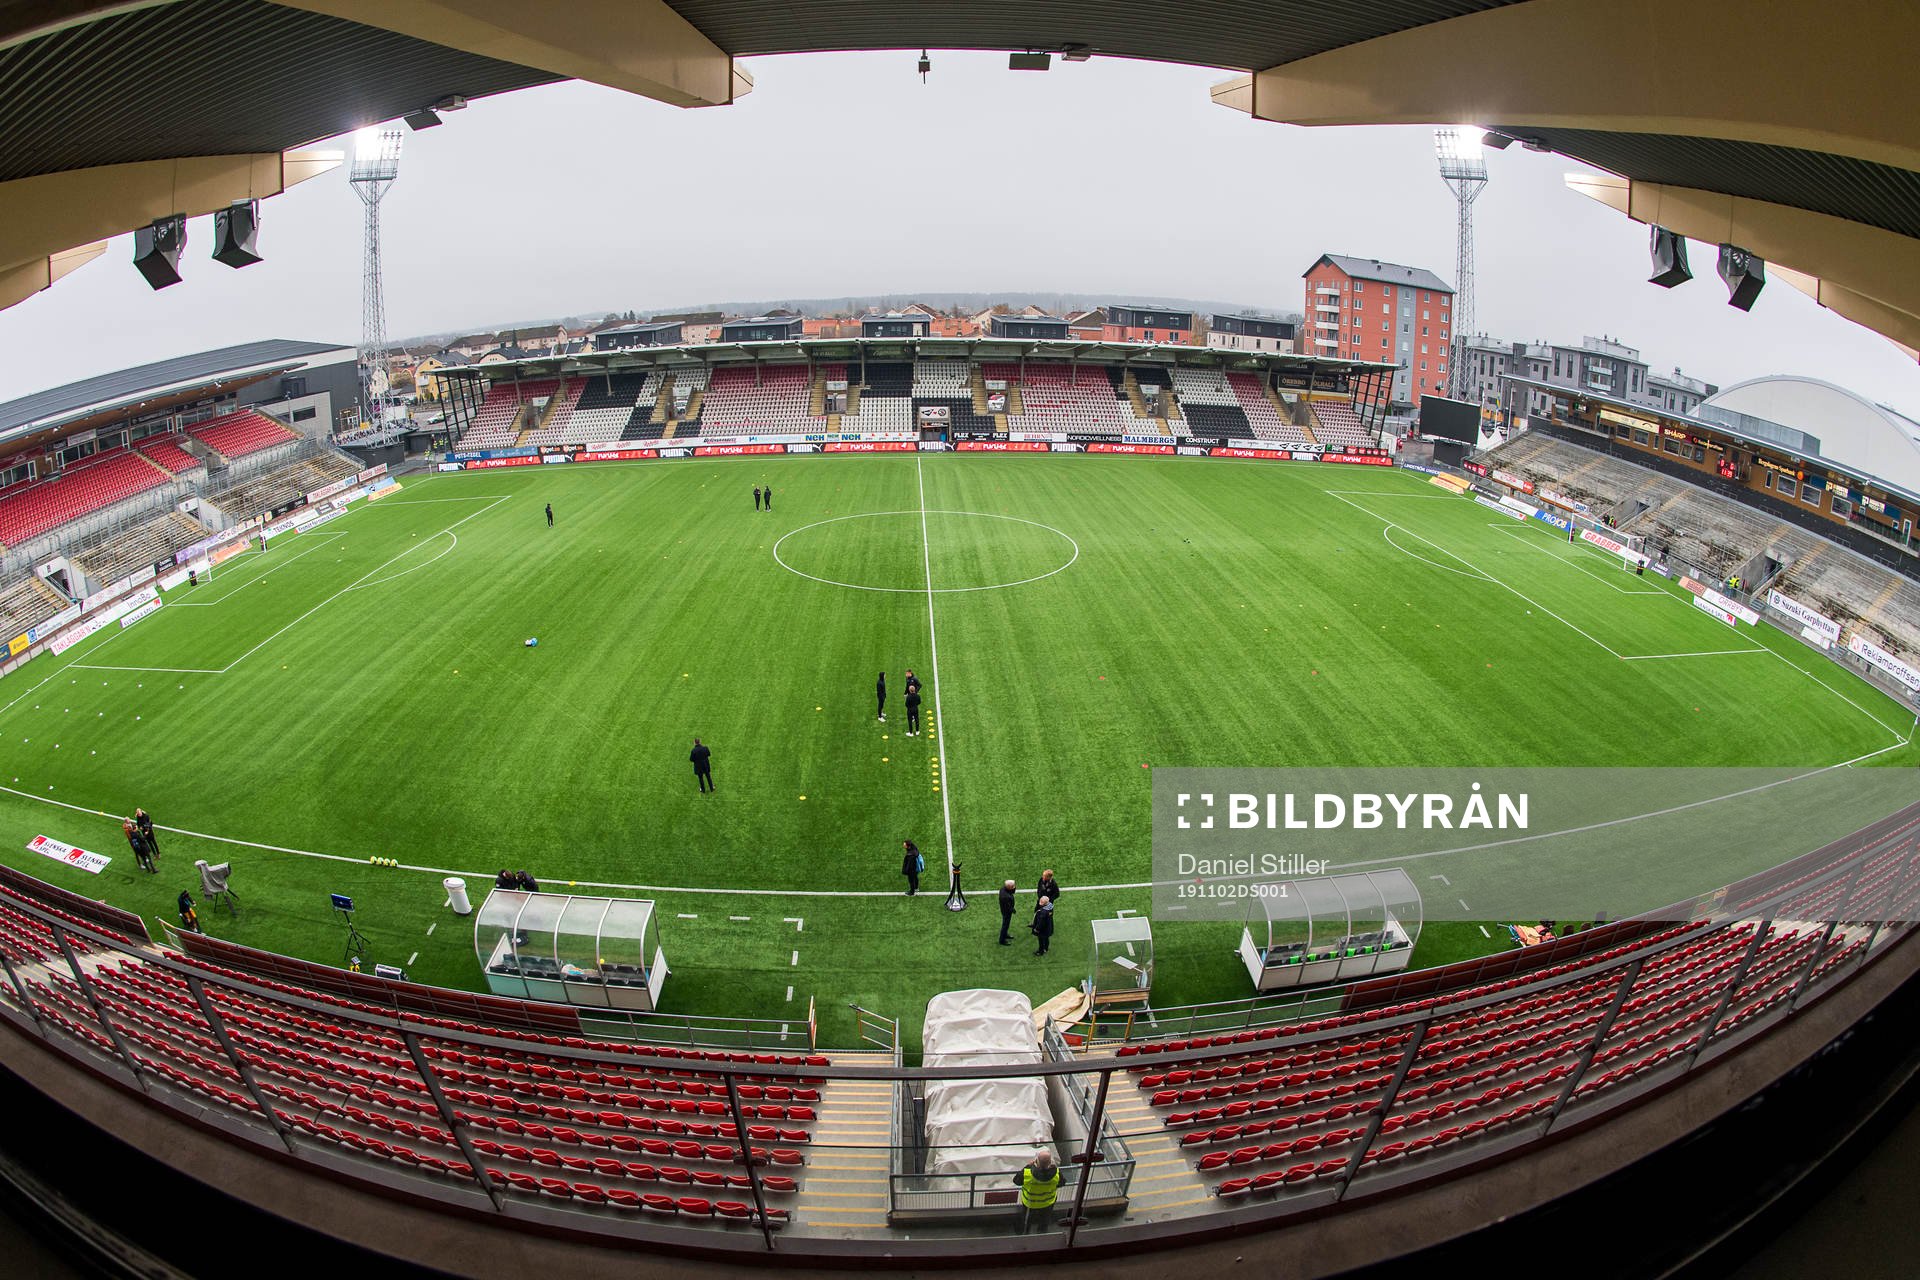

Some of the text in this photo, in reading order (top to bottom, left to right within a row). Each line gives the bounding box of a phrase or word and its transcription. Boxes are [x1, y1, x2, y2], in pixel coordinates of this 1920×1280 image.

[919, 441, 945, 450] PUMA
[1124, 435, 1175, 444] MALMBERGS
[660, 448, 684, 457] PUMA
[787, 444, 812, 452] PUMA
[1051, 443, 1077, 452] PUMA
[273, 520, 295, 534] TEKNOS
[1541, 512, 1568, 529] PROJOB
[1584, 532, 1621, 553] GRABBER
[127, 593, 151, 609] InnoBo
[1781, 599, 1835, 635] Suzuki Garphyttan
[1861, 643, 1920, 686] Reklamproffsen
[81, 854, 107, 866] SVENSKA
